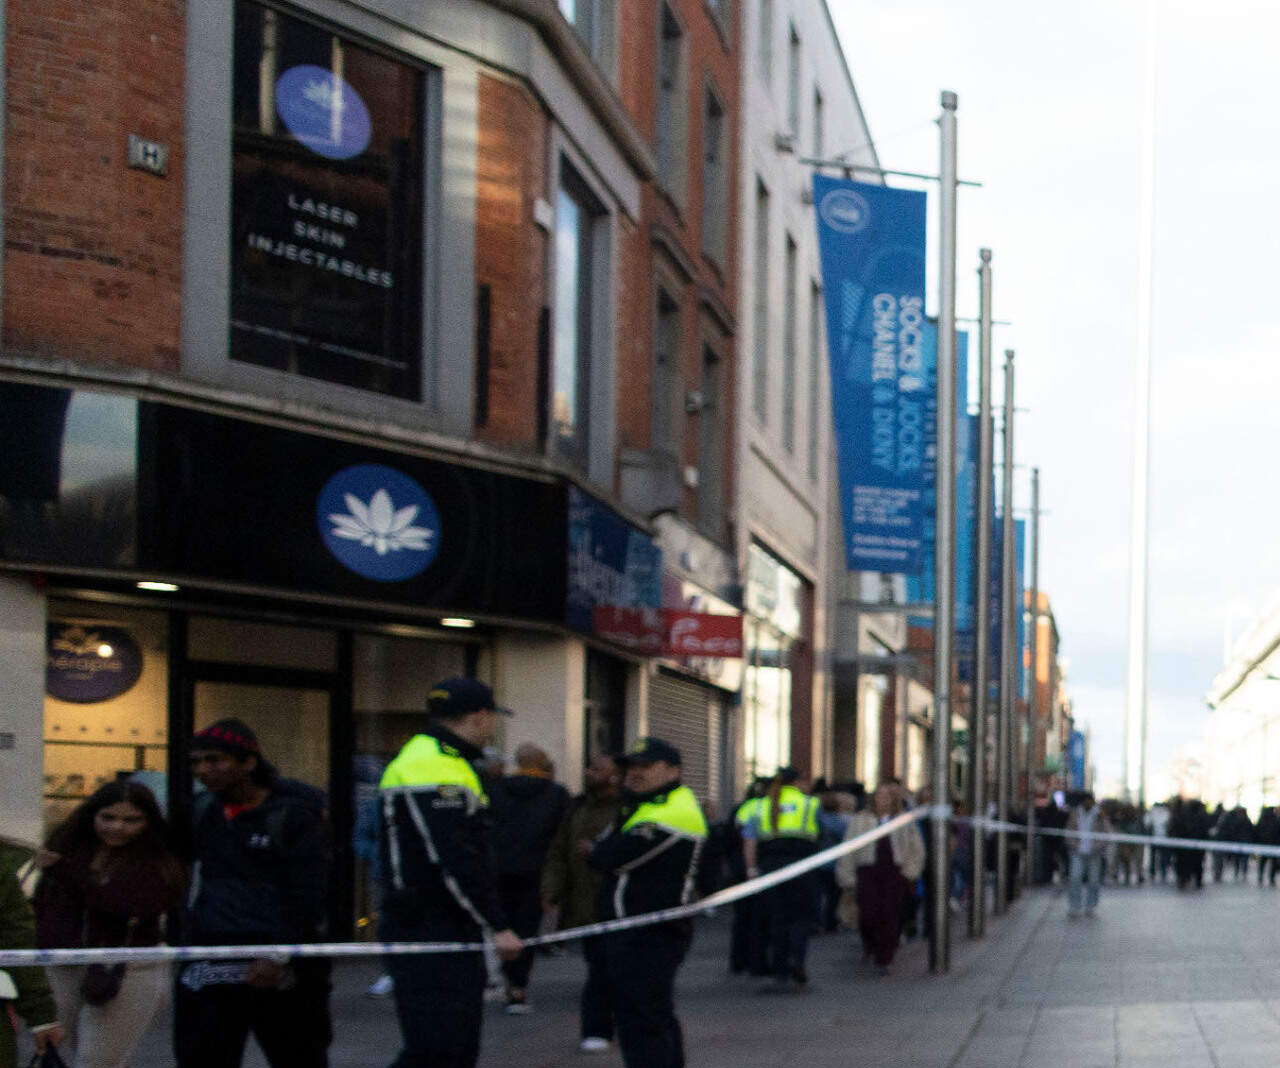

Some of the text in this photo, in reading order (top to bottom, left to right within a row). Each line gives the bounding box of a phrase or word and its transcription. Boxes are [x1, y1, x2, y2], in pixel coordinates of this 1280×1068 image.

[288, 193, 358, 227] LASER
[294, 219, 346, 248] SKIN
[247, 232, 393, 288] INJECTABLES
[871, 293, 897, 382] CHANEL
[898, 295, 922, 373] SOCKS
